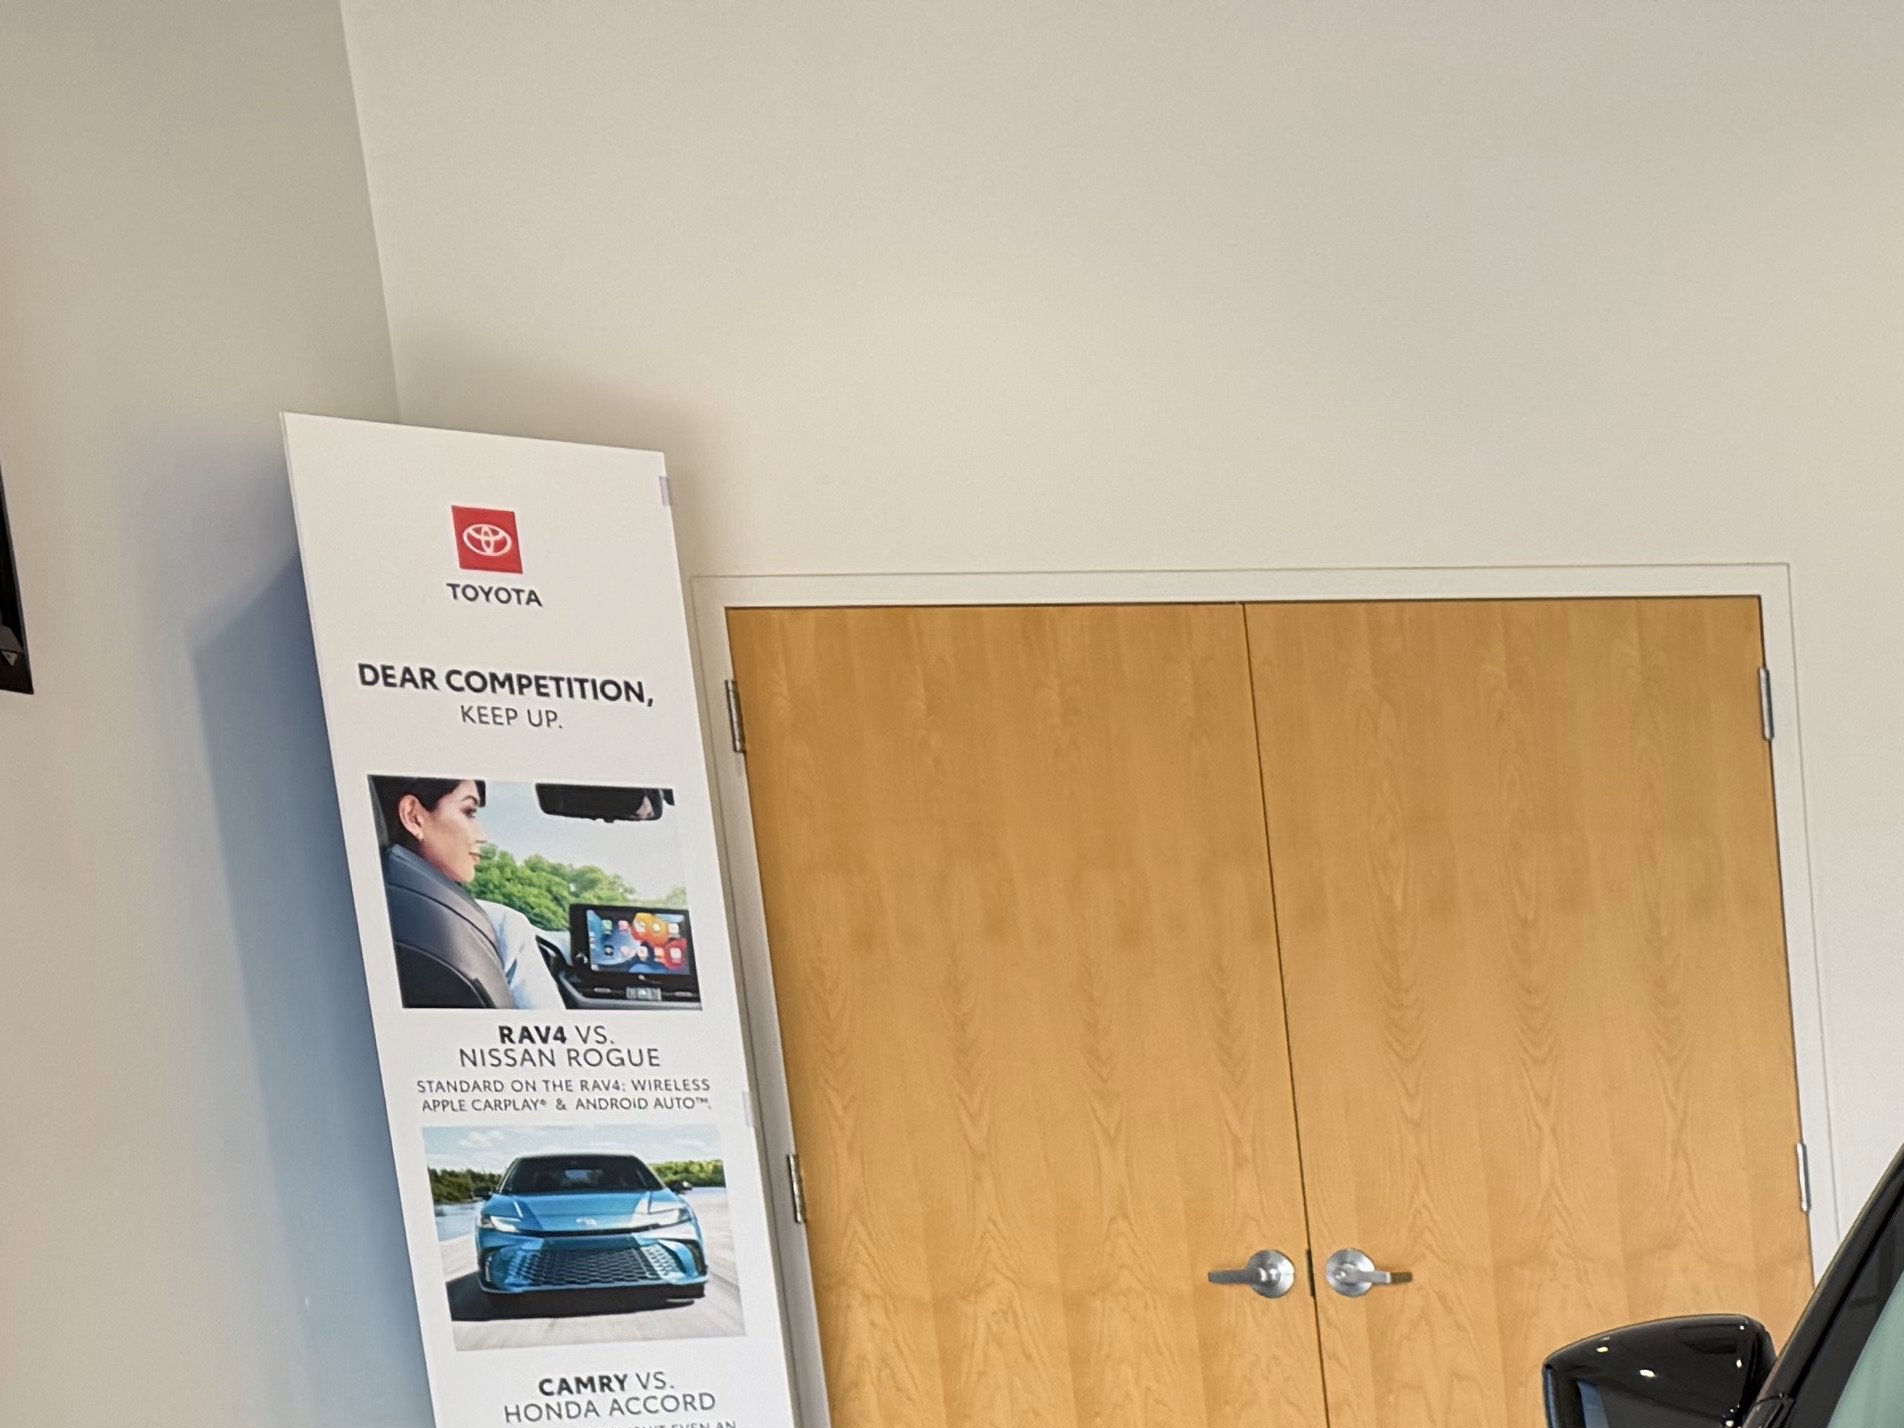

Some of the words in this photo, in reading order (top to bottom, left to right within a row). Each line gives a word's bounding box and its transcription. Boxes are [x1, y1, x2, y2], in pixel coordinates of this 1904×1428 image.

[446, 582, 543, 608] TOYOTA
[358, 662, 439, 691] DEAR
[445, 669, 654, 708] COMPETITION,
[461, 705, 519, 728] KEEP
[527, 708, 562, 729] UP.
[499, 1025, 567, 1045] RAV4
[575, 1024, 614, 1043] VS.
[460, 1048, 556, 1068] NISSAN
[568, 1047, 661, 1067] ROGUE
[417, 1079, 504, 1093] STANDARD
[511, 1079, 536, 1093] ON
[542, 1079, 573, 1092] THE
[580, 1079, 626, 1092] RAV4:
[631, 1078, 710, 1092] WIRELESS
[422, 1098, 466, 1112] APPLE
[555, 1098, 566, 1111] &
[575, 1097, 648, 1110] ANDROID
[538, 1374, 628, 1397] CAMRY
[635, 1371, 674, 1391] VS.
[504, 1400, 600, 1423] HONDA
[608, 1392, 716, 1417] ACCORD
